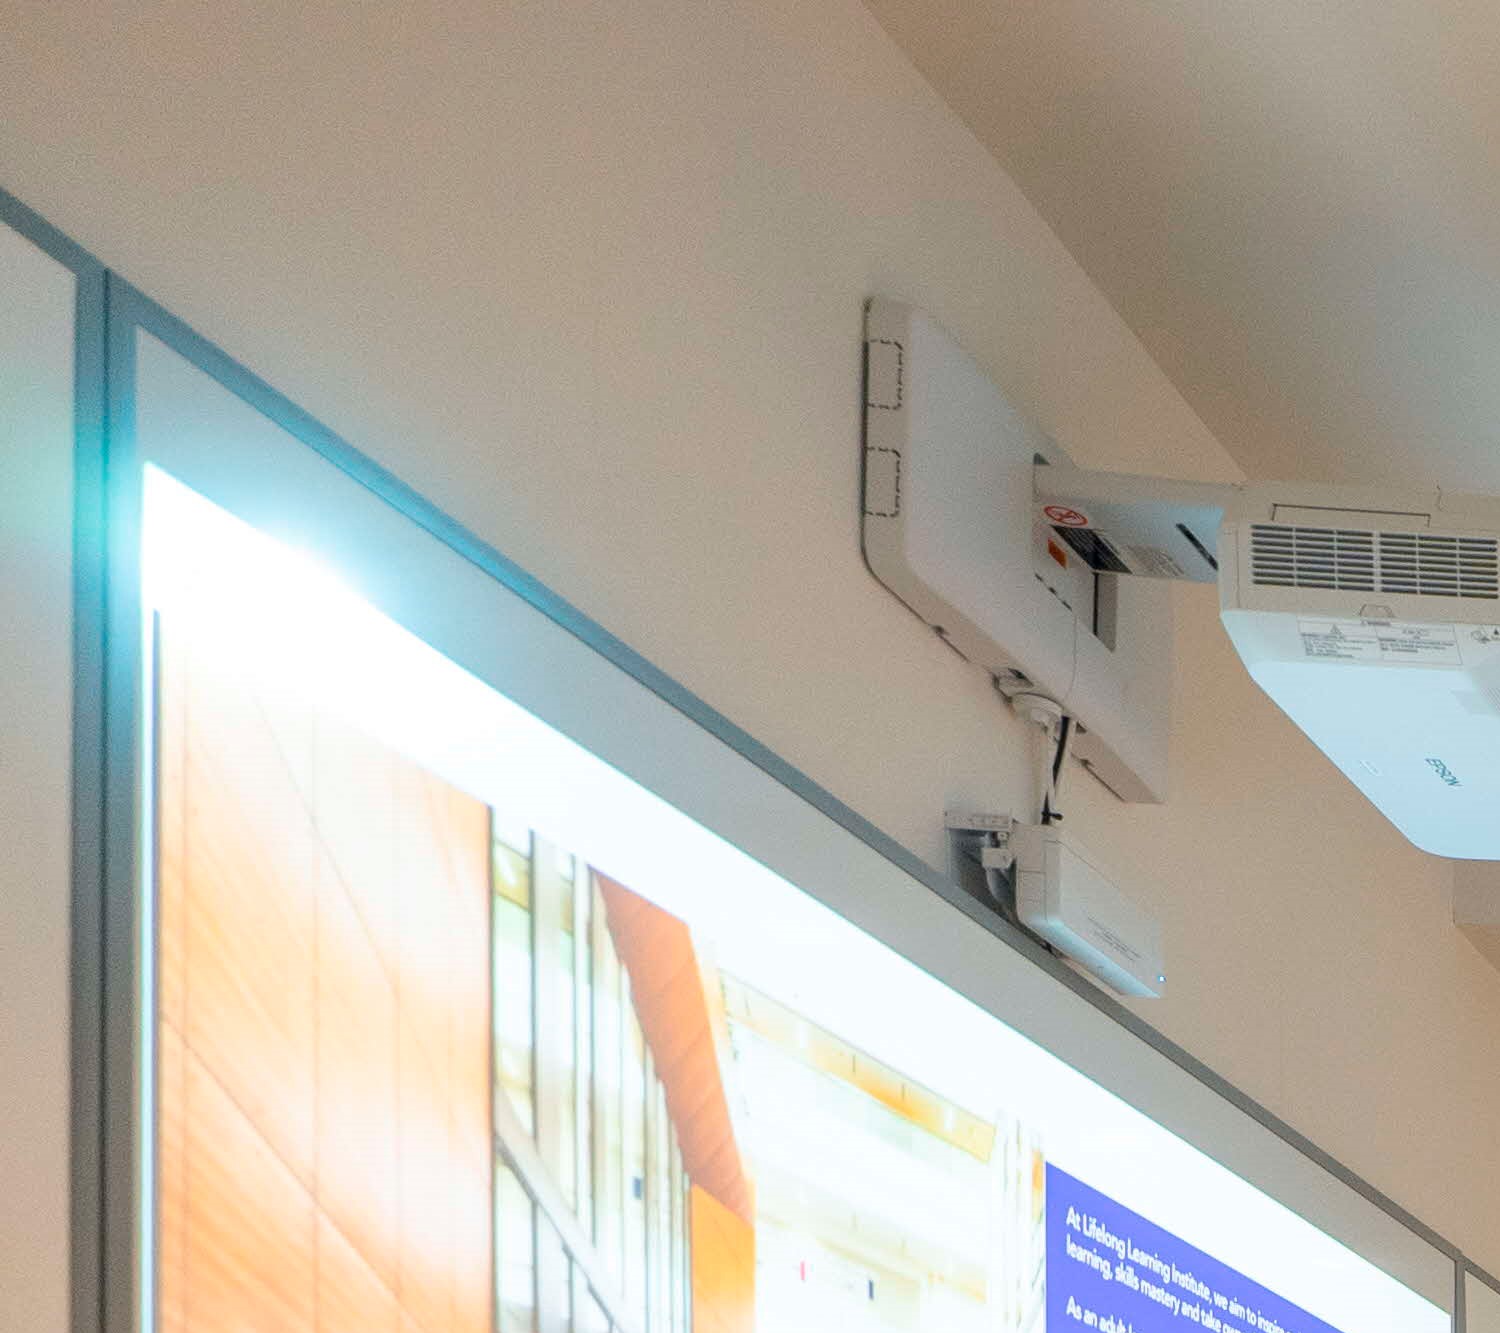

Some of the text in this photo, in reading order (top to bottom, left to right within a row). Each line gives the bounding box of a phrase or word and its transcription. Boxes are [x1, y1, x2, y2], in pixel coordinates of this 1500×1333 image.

[1425, 758, 1464, 787] EPSON
[1066, 1205, 1081, 1232] At
[1083, 1213, 1126, 1260] Lifelong
[1127, 1237, 1171, 1284] Learning
[1171, 1262, 1213, 1305] Institute,
[1213, 1291, 1229, 1311] we
[1229, 1296, 1246, 1320] aim
[1246, 1306, 1257, 1326] to
[1066, 1233, 1114, 1281] learning,
[1115, 1261, 1139, 1291] skills
[1140, 1279, 1181, 1316] mastery
[1181, 1301, 1200, 1323] and
[1200, 1308, 1222, 1333] take
[1066, 1295, 1082, 1321] As
[1083, 1308, 1098, 1328] an
